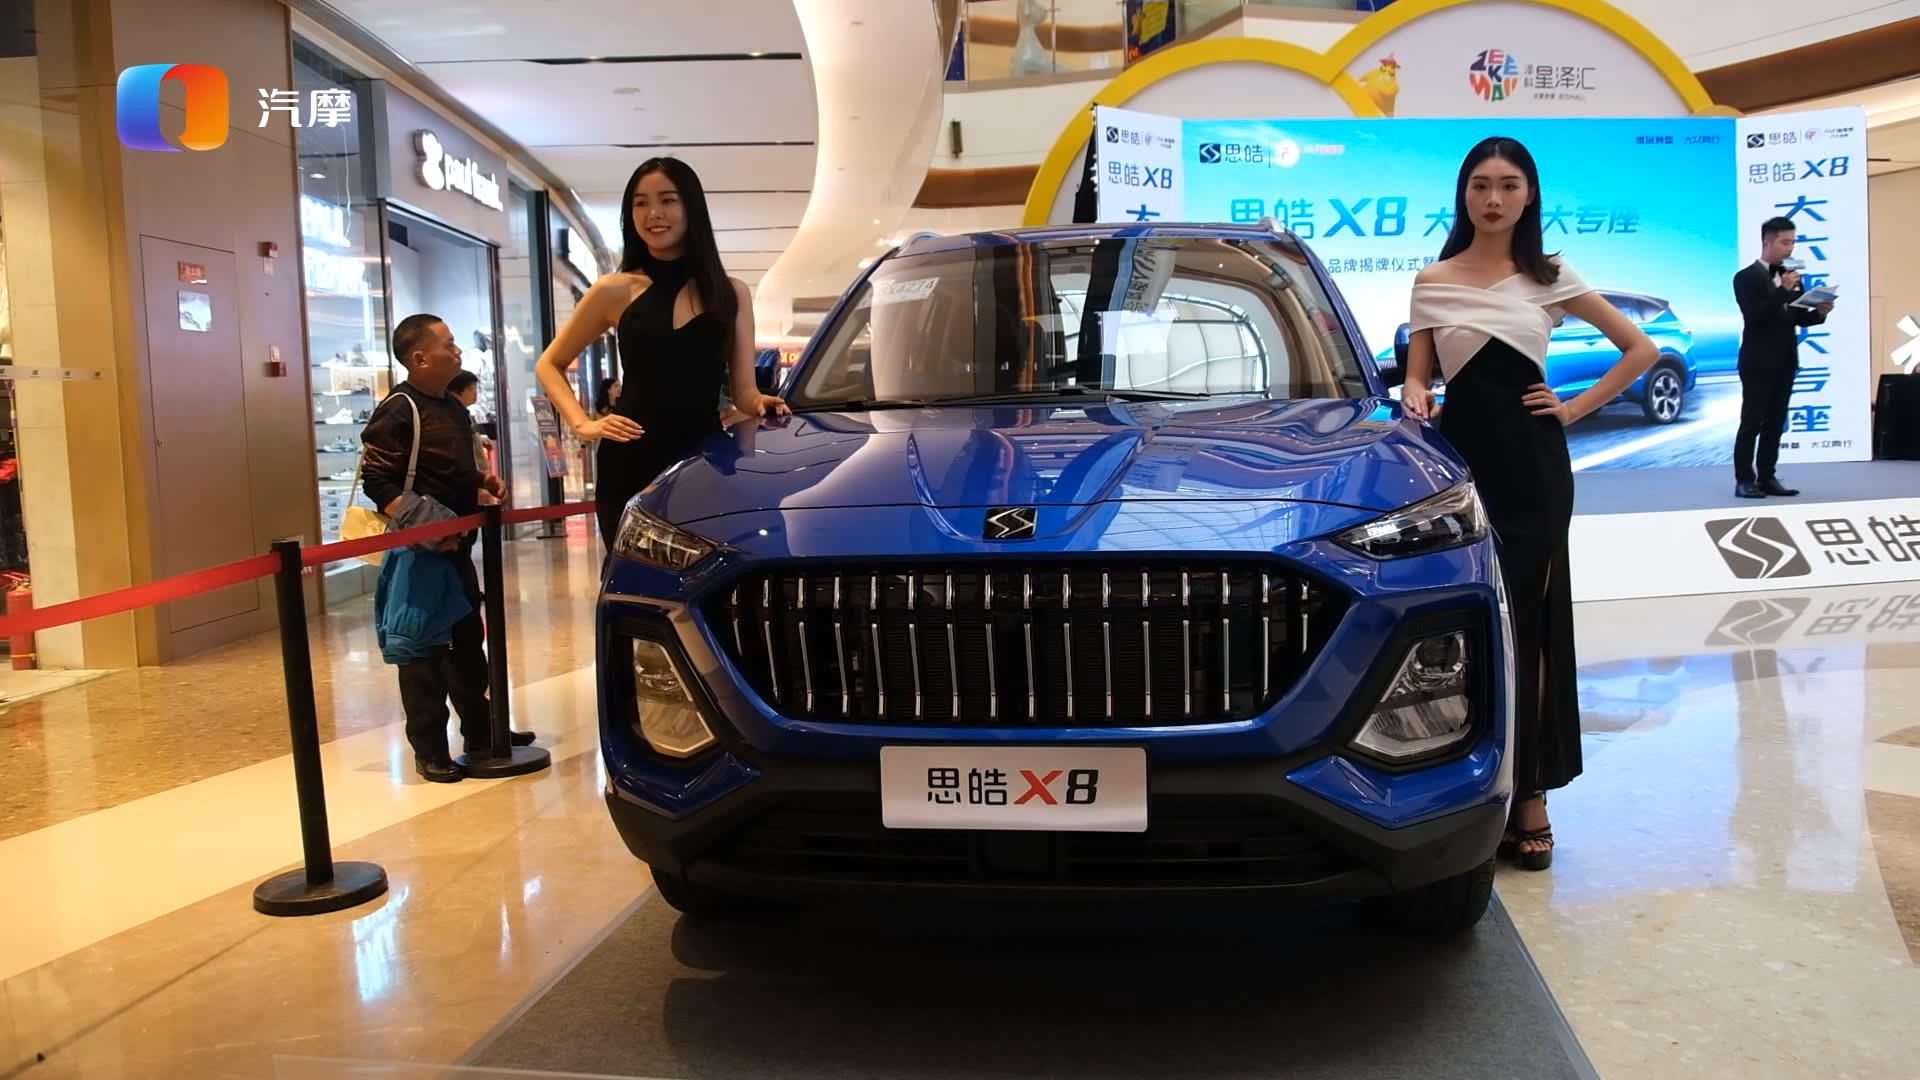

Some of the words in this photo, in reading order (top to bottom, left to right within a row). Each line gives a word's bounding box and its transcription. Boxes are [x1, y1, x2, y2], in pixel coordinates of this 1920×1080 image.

[1535, 65, 1597, 90] 星泽汇
[1225, 143, 1264, 164] 思皓
[1108, 160, 1172, 190] 思皓X8
[1749, 156, 1850, 184] 思皓X8
[1231, 196, 1409, 239] 思皓X8
[1805, 514, 1920, 566] 思皓
[927, 767, 1099, 806] 思皓X8
